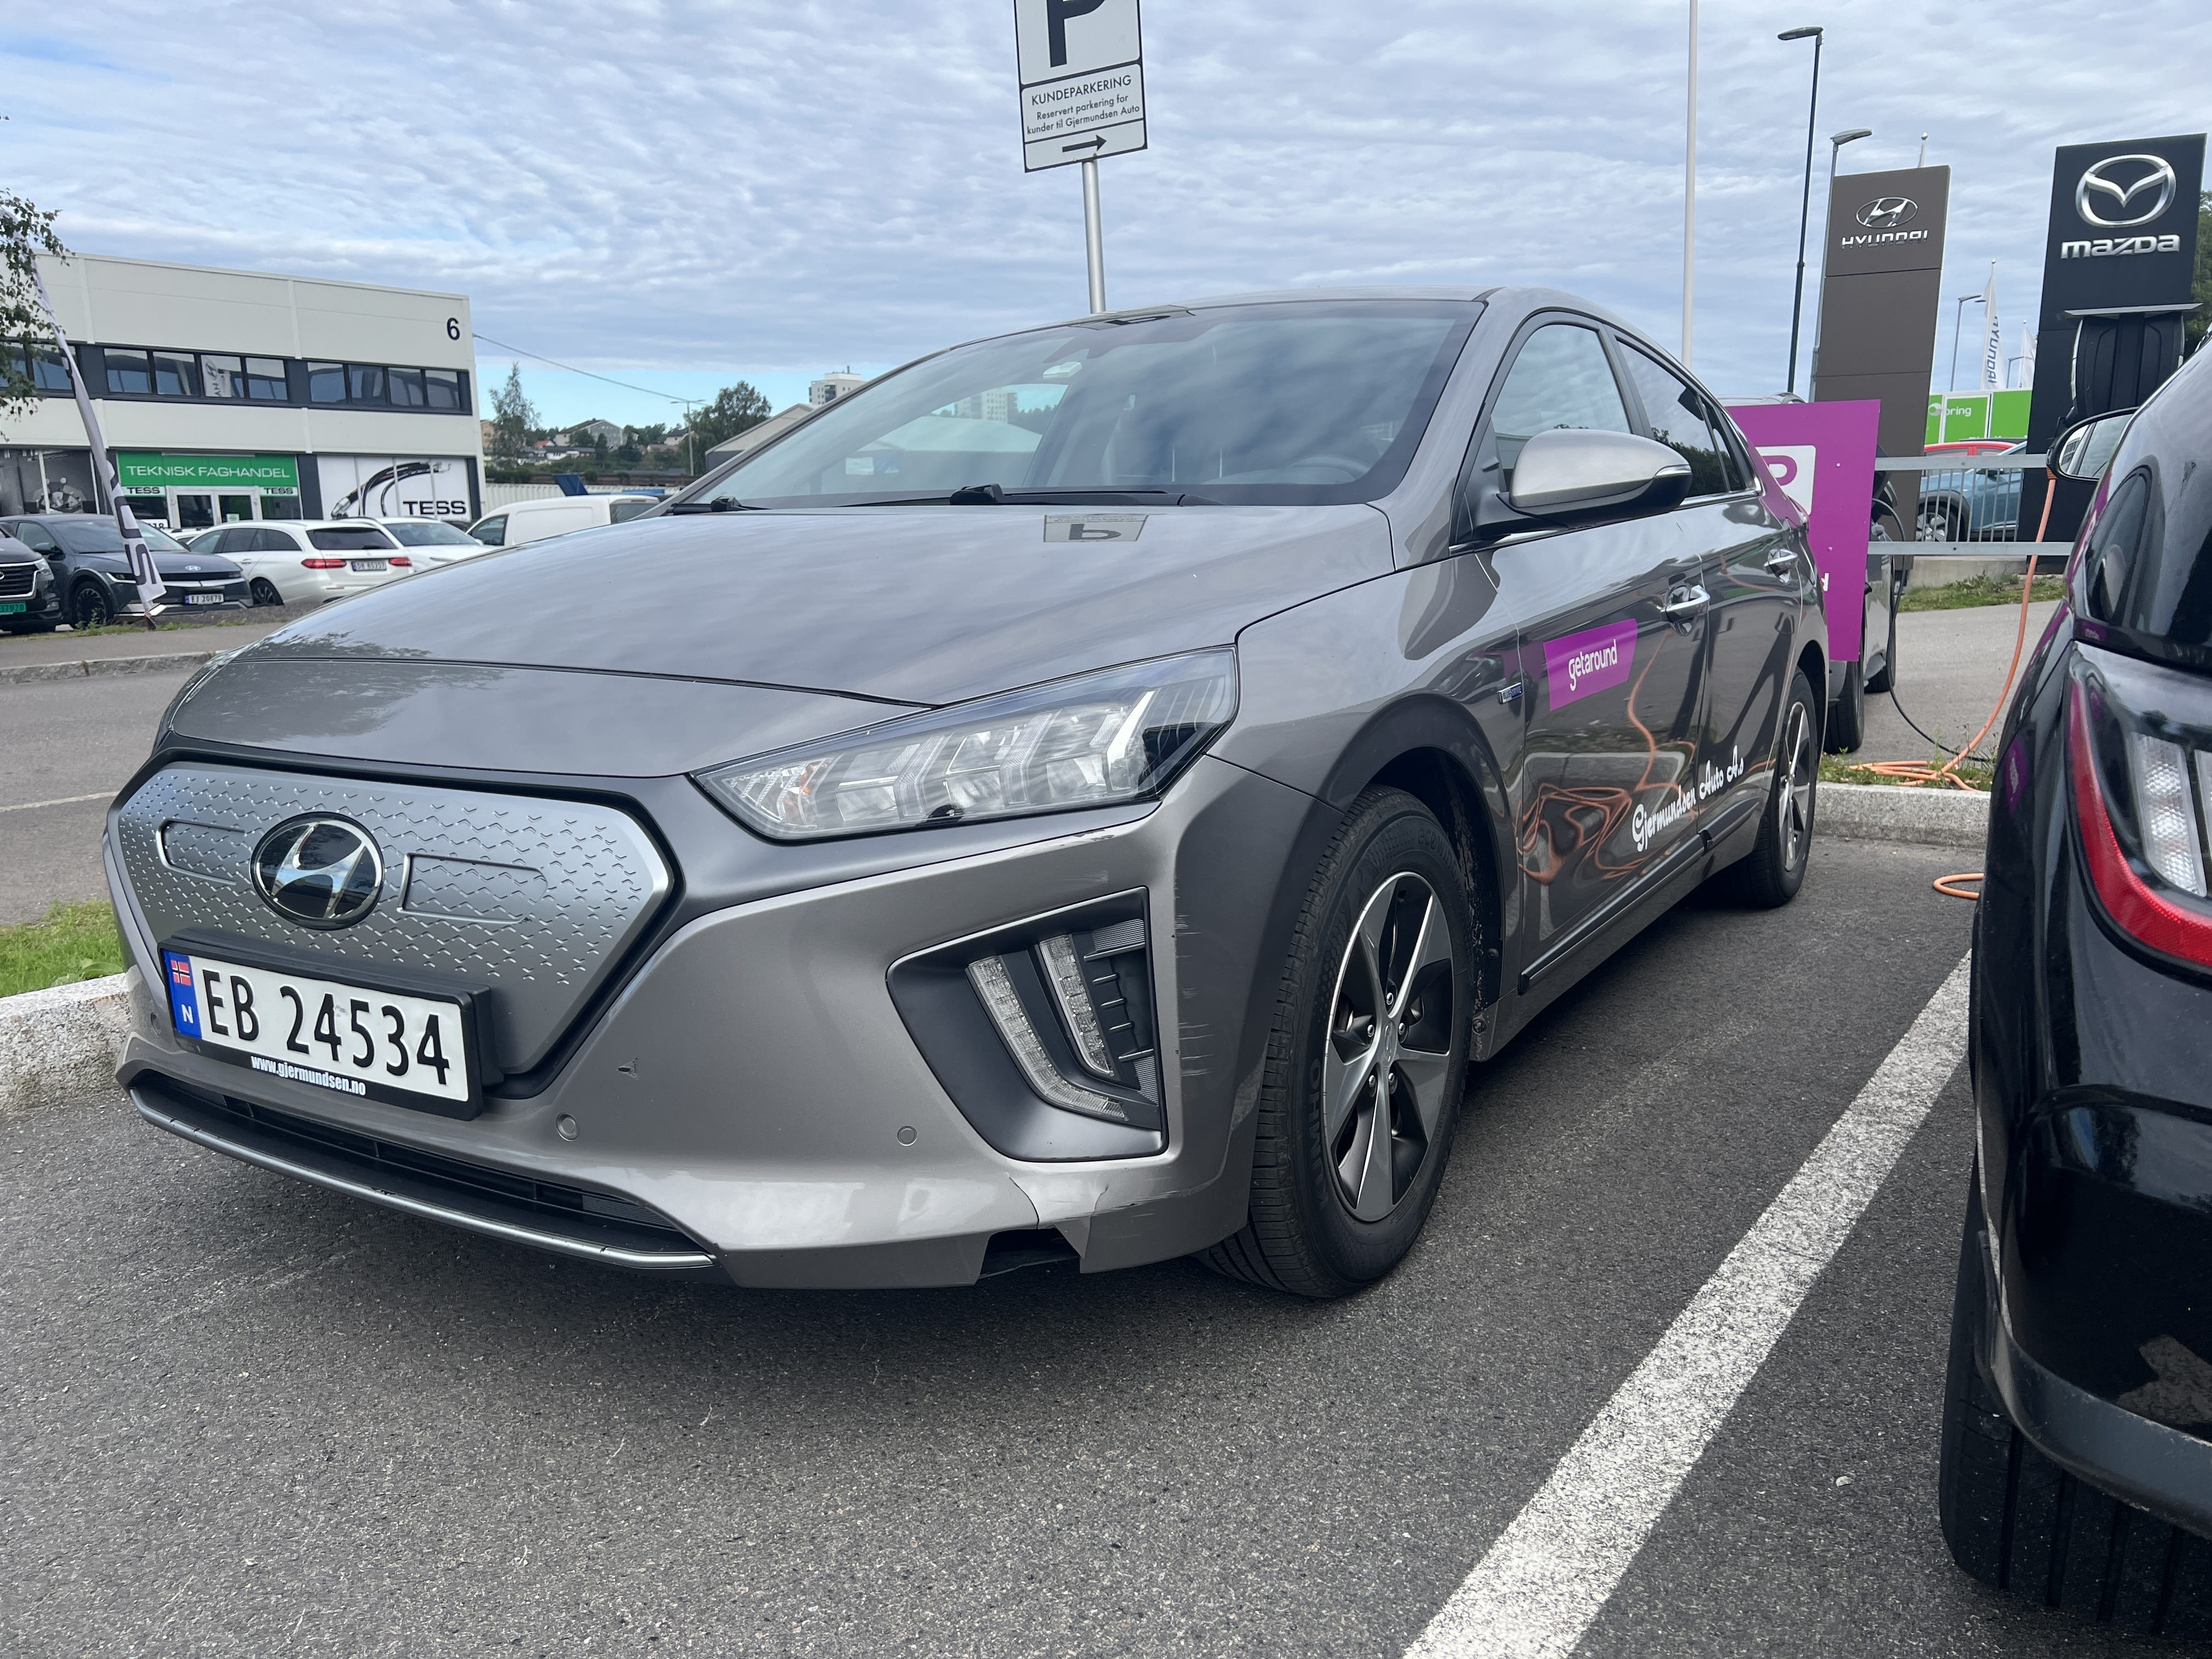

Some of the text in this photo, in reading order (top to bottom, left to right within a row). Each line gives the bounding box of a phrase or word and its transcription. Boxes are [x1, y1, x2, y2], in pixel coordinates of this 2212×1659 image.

[1032, 75, 1131, 105] KUNDEPARKERING
[1027, 122, 1054, 134] kunder
[1065, 110, 1118, 127] Gjermundsen
[1120, 105, 1140, 115] Auto
[1037, 94, 1128, 120] Reservert parkering for
[1842, 230, 1928, 250] HYUNDAI
[447, 318, 460, 340] 6
[126, 466, 290, 478] TEKNISK FAGHANDEL
[403, 501, 466, 515] TESS
[1568, 639, 1617, 691] getaround
[1632, 785, 1696, 852] Gjermundsen
[1700, 759, 1724, 800] Auto
[181, 969, 450, 1086] N EB 24534
[251, 1056, 366, 1096] www.gjermundsen.no
